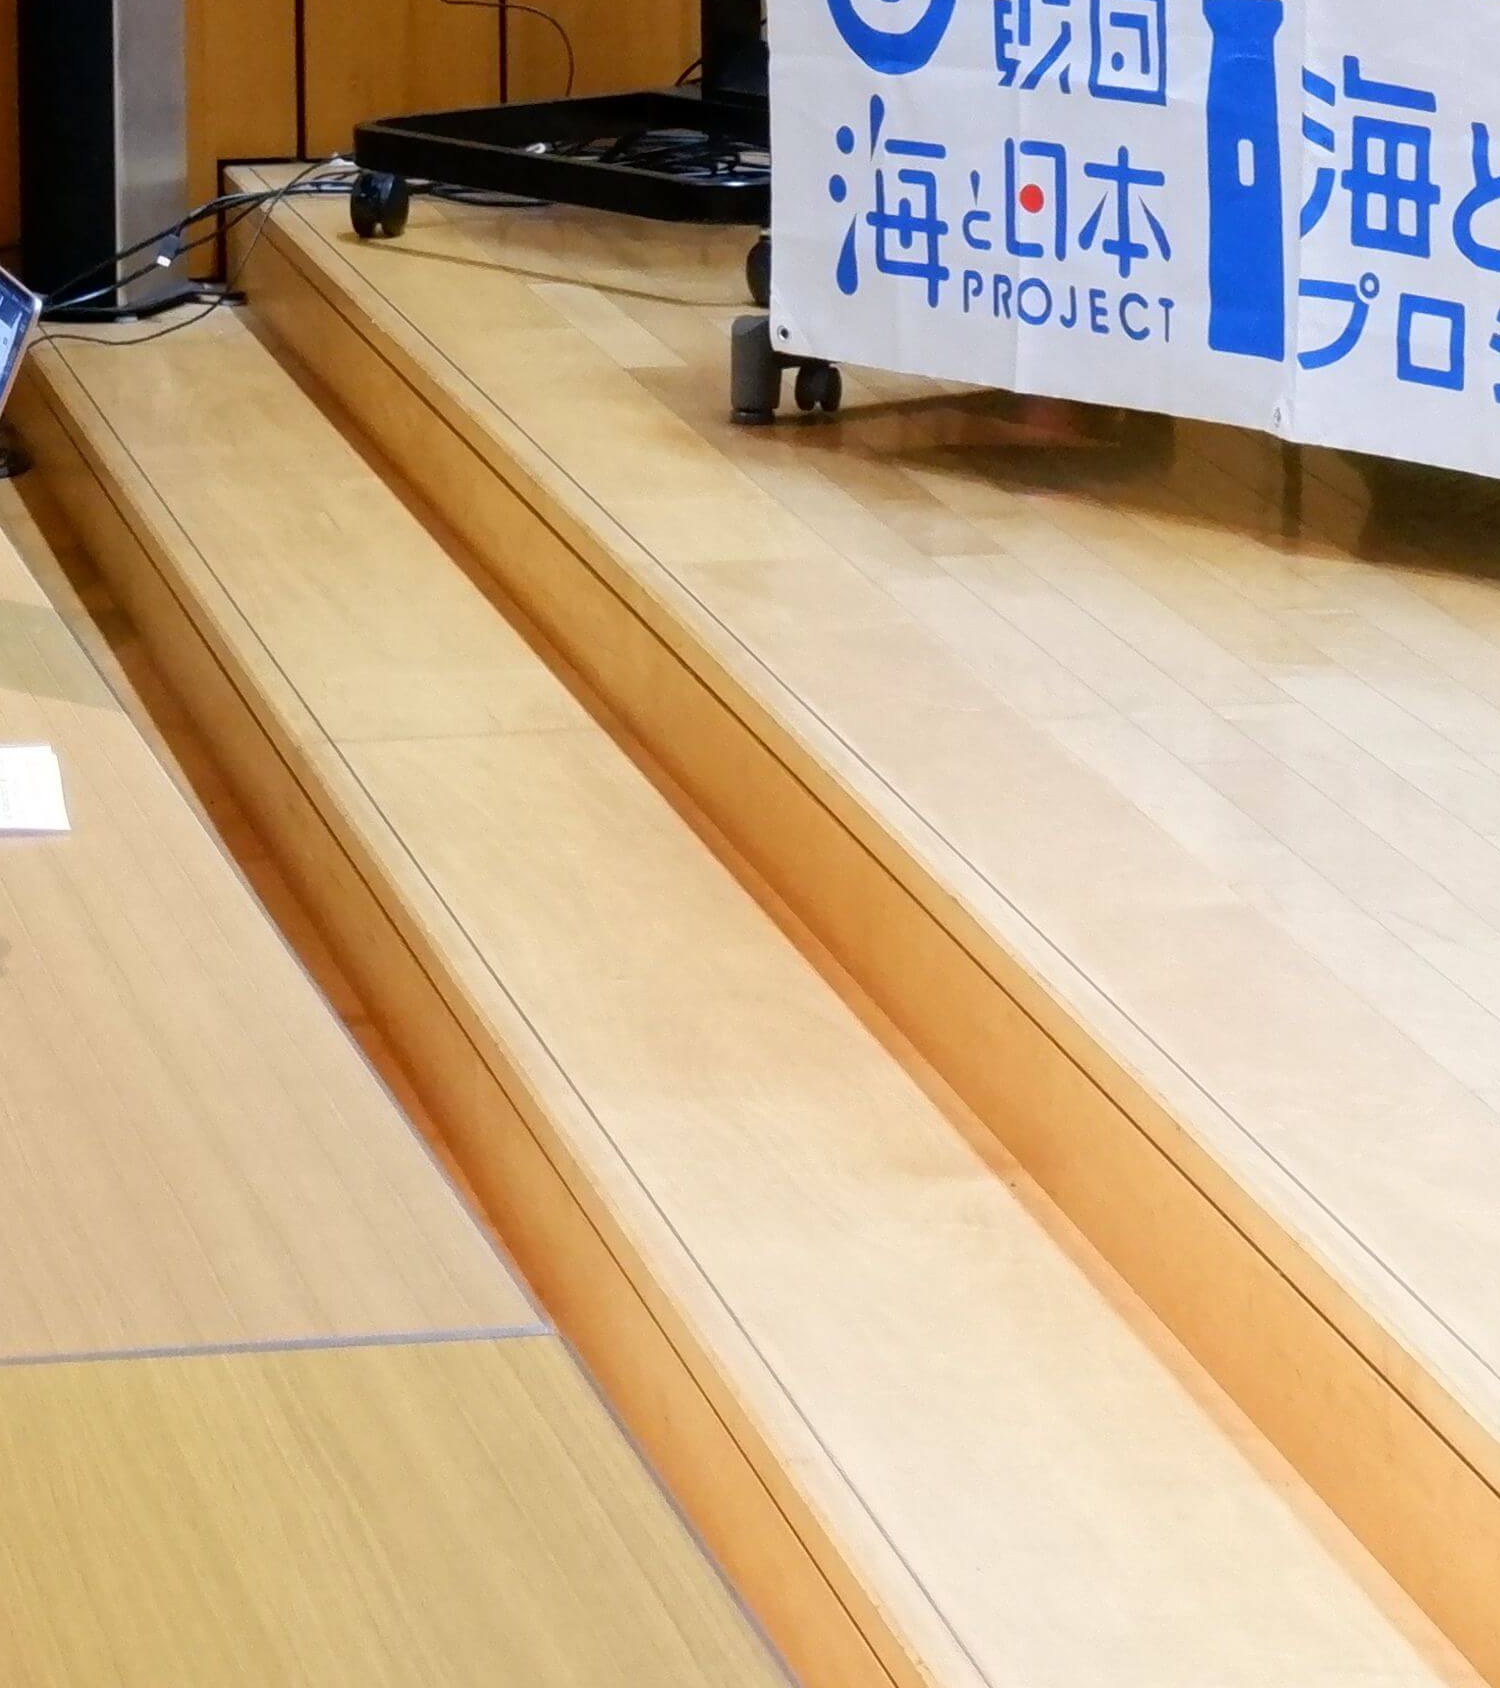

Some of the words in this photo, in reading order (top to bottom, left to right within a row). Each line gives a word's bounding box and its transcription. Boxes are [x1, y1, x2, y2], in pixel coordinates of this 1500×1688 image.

[828, 94, 1173, 309] 海と日本
[961, 268, 1177, 344] PROJECT
